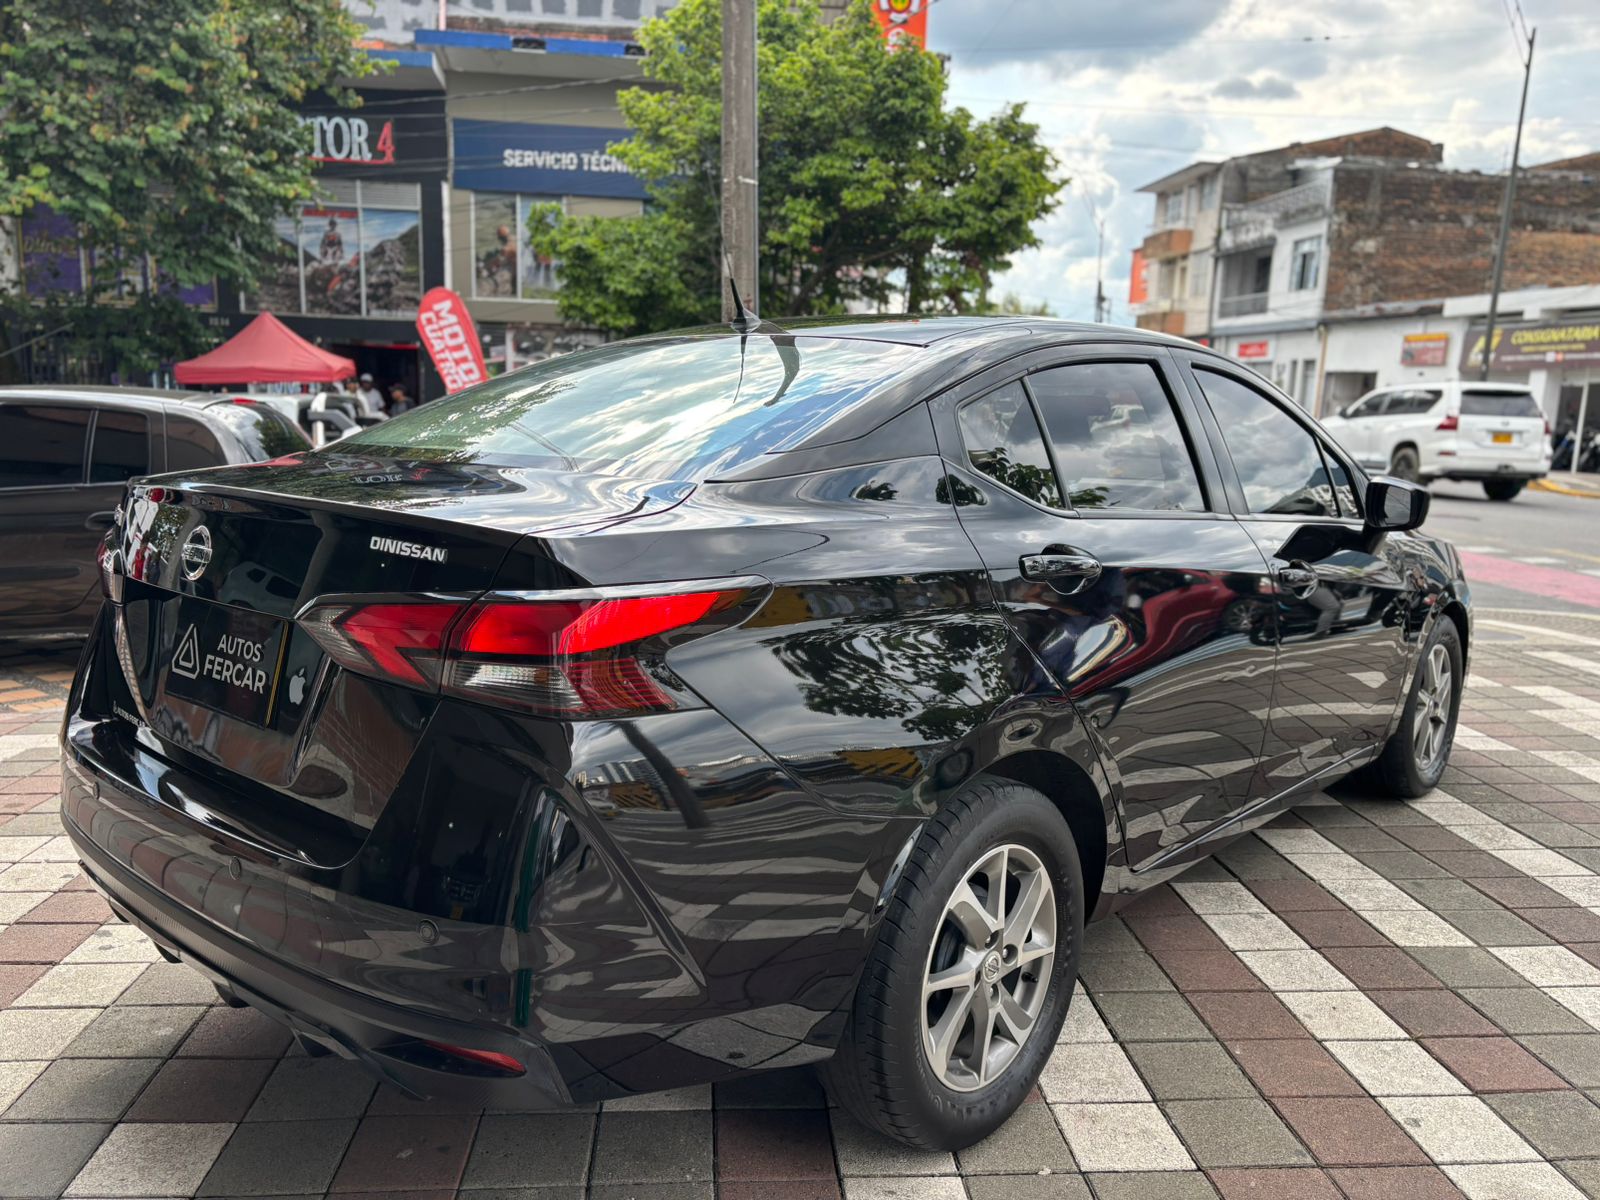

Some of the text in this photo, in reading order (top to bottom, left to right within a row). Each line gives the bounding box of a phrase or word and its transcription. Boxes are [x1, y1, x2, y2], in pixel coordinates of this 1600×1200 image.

[299, 115, 396, 164] TOR 4
[503, 149, 578, 170] SERVICIO
[420, 311, 464, 390] CUATRO
[433, 299, 481, 387] MOTO
[217, 634, 262, 662] AUTOS
[203, 654, 266, 694] FERCAR
